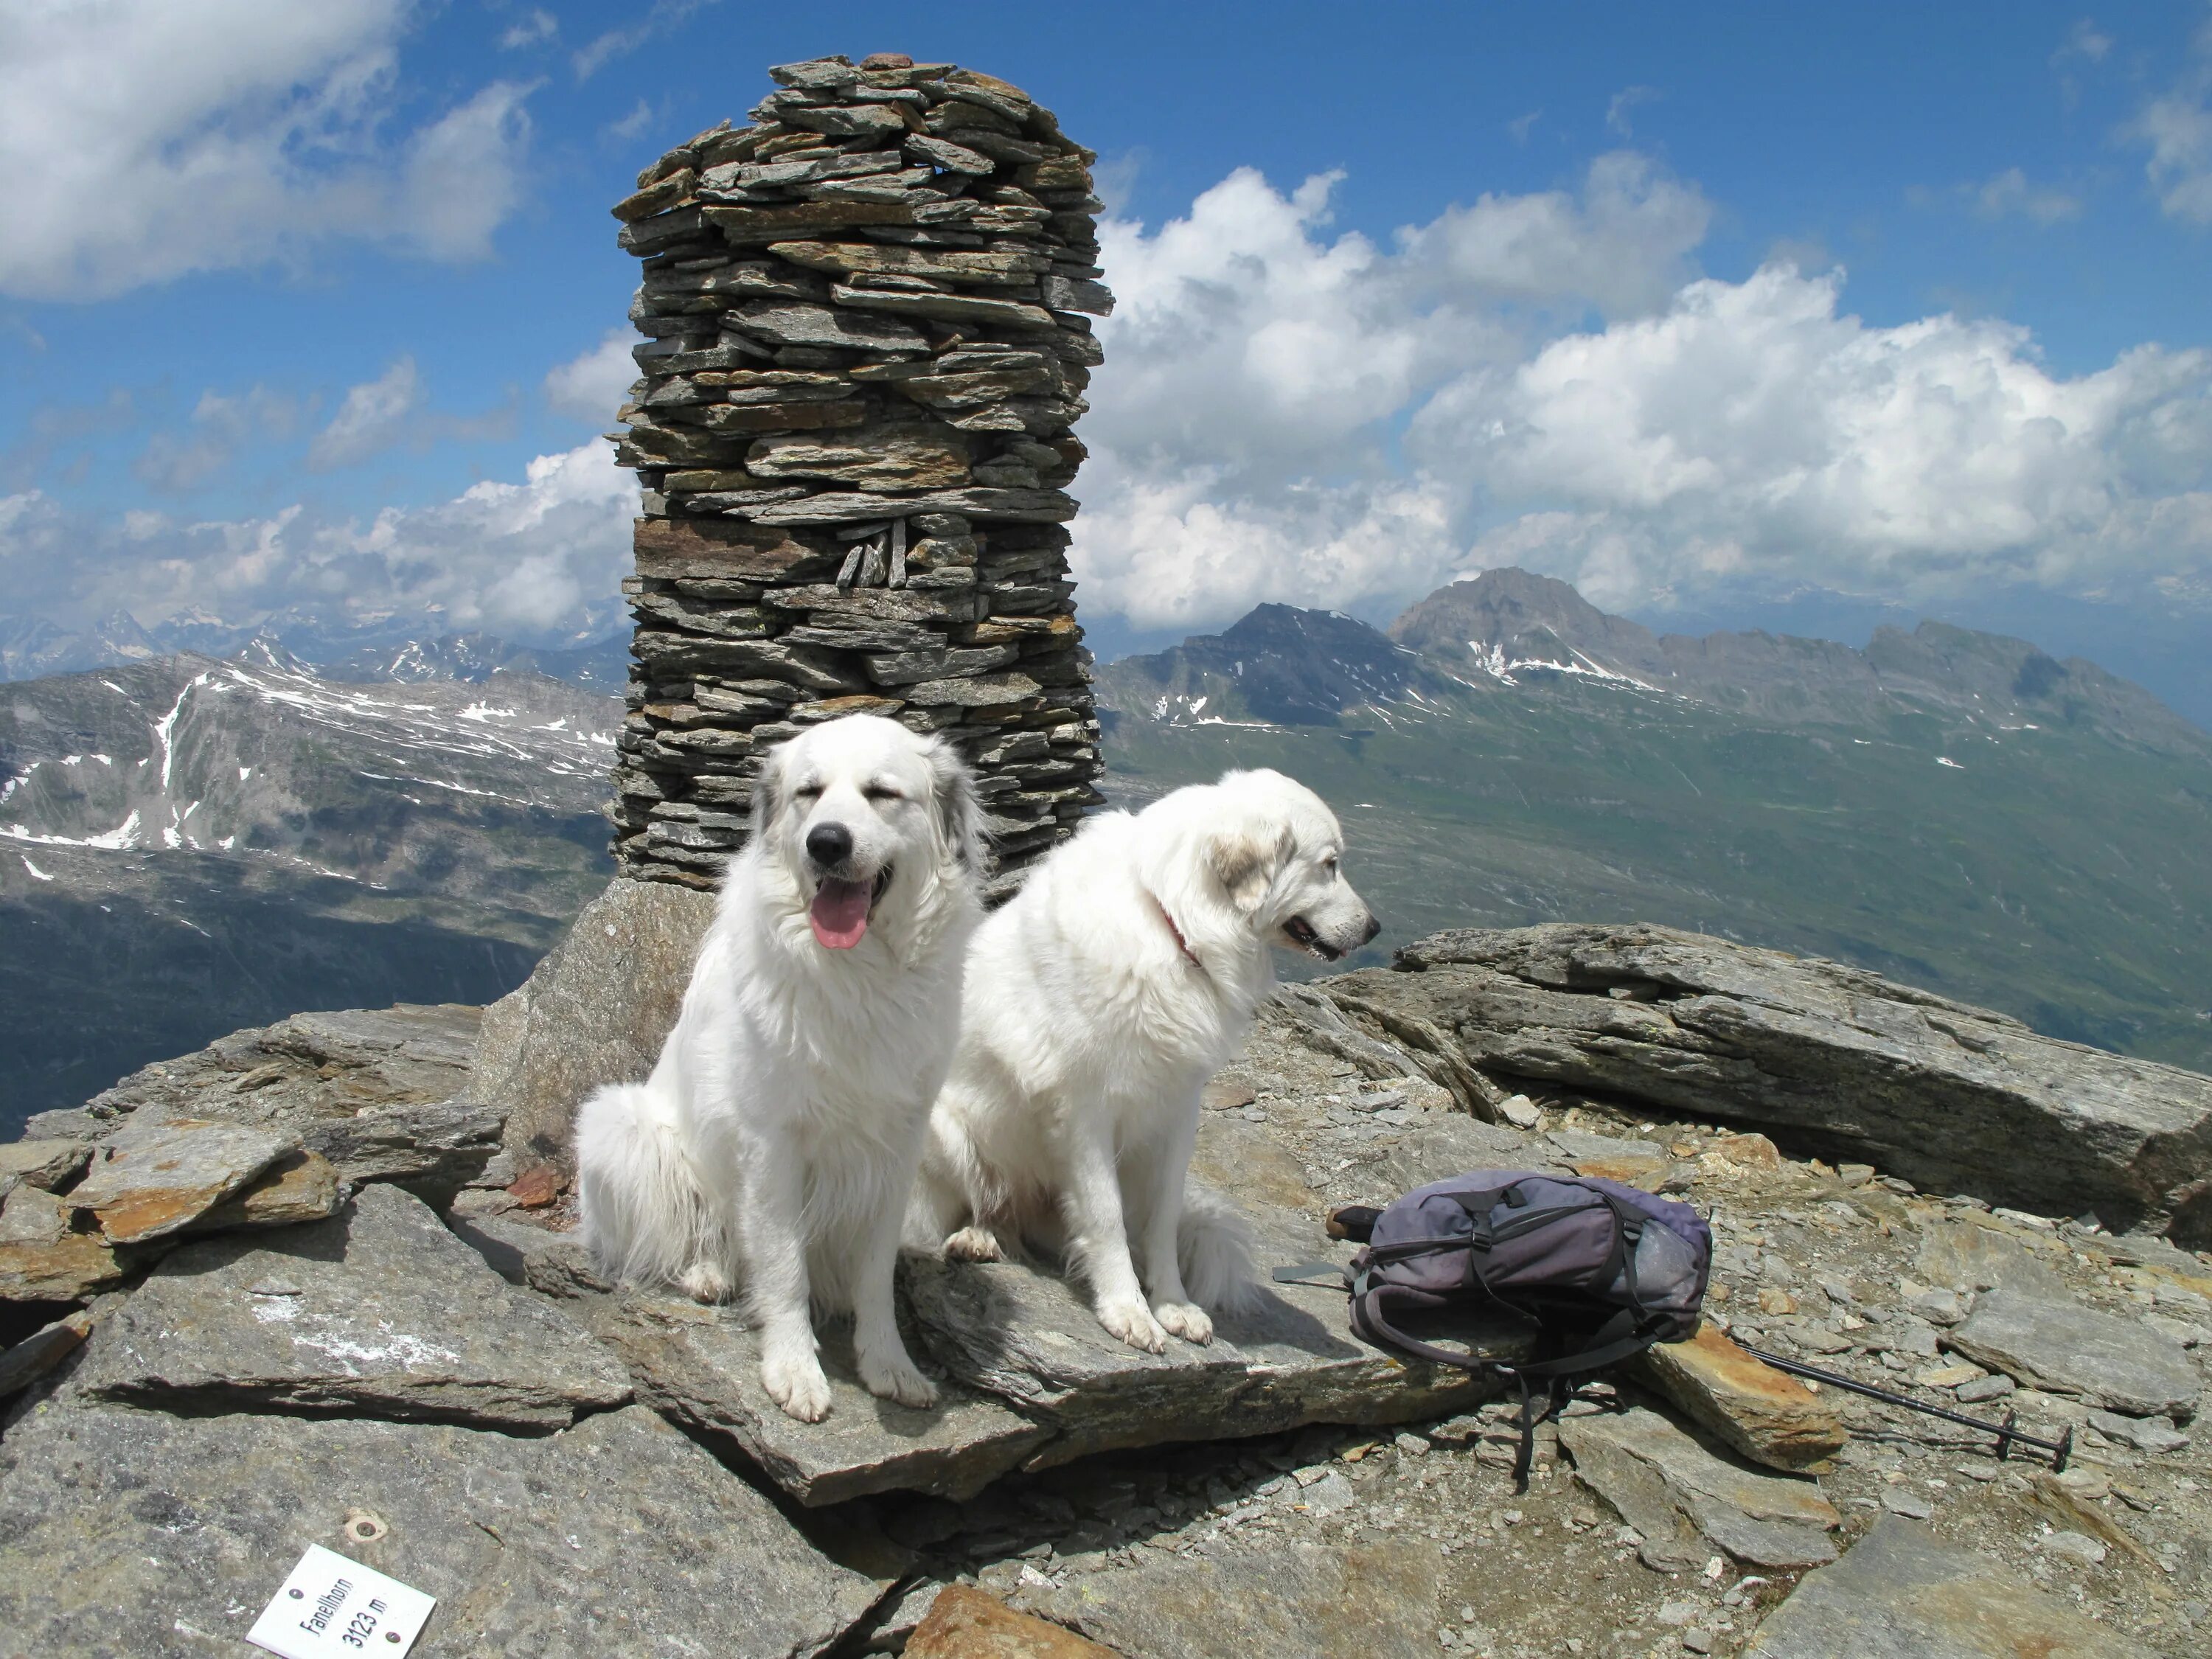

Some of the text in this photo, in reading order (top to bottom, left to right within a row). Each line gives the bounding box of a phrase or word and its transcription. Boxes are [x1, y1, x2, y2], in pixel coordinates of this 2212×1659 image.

[299, 1579, 353, 1637] Fanellhorn
[342, 1599, 388, 1648] 3123 m
